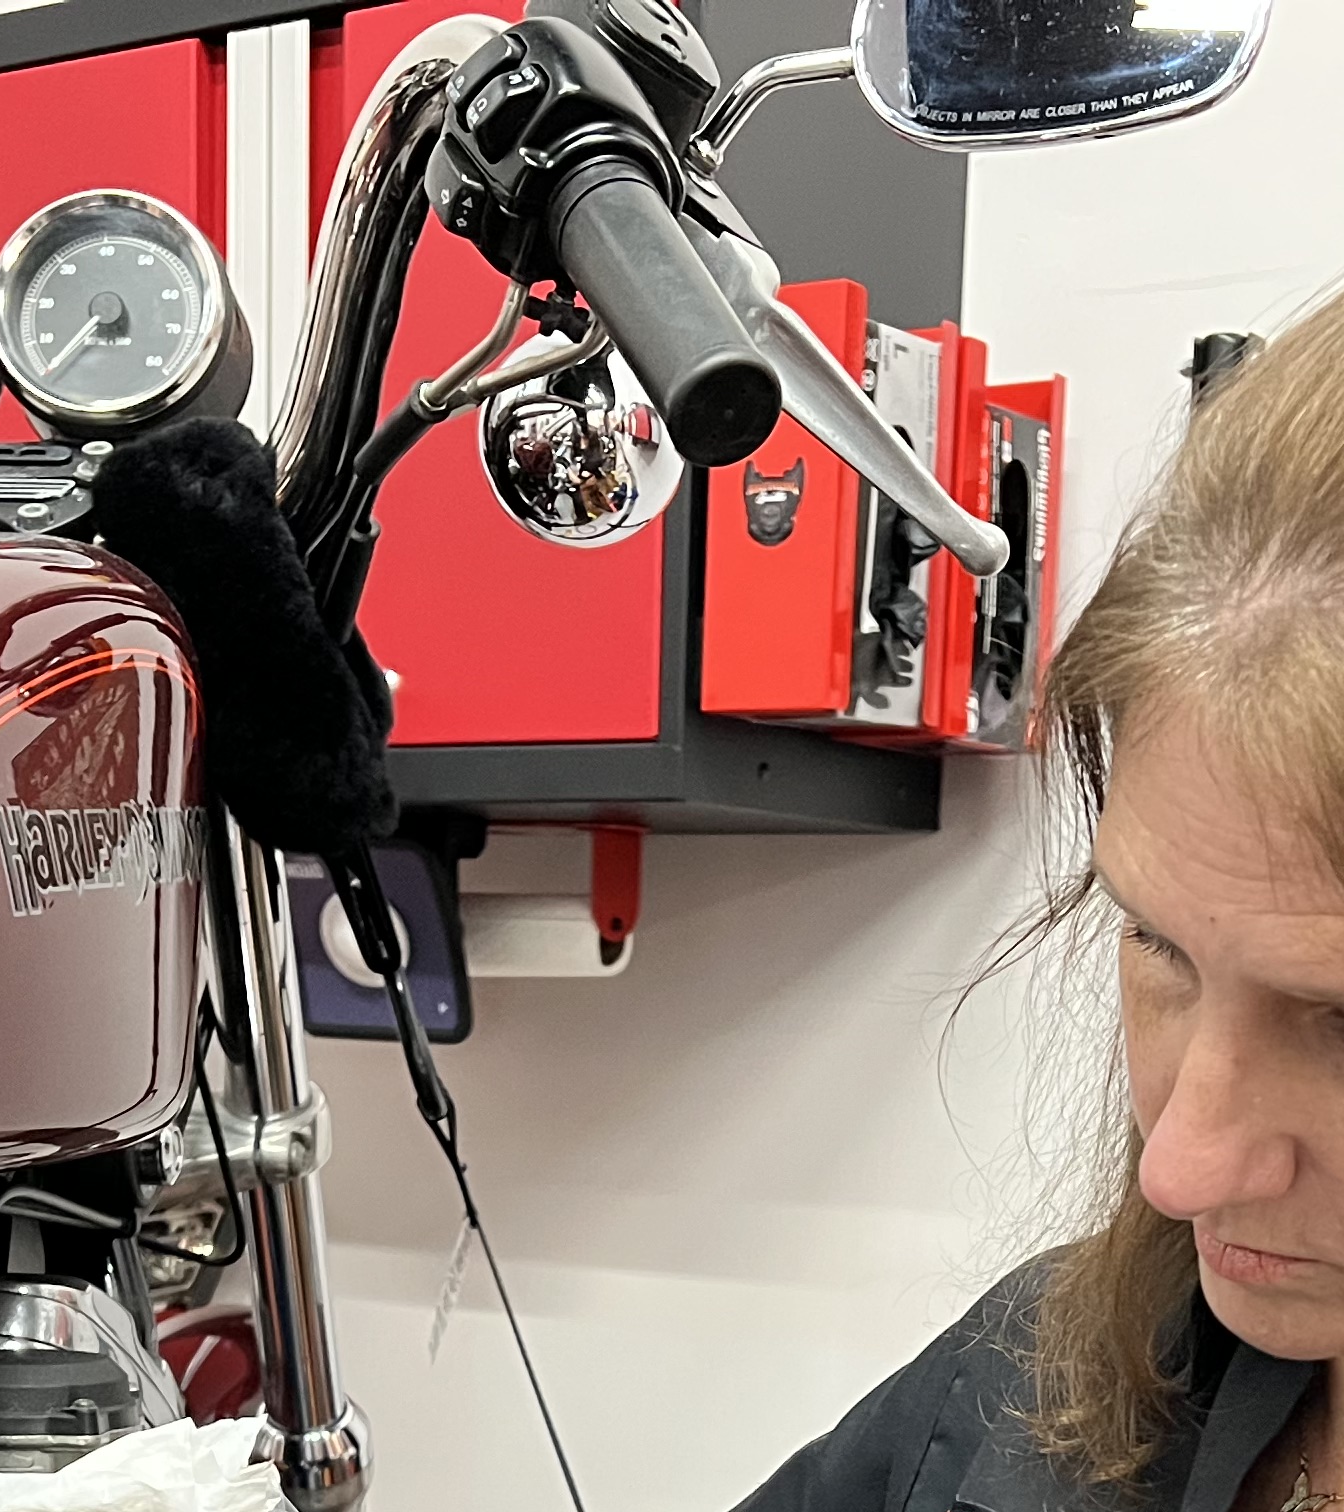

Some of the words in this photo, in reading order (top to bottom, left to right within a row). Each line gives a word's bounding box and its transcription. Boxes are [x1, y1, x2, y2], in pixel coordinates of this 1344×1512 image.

[962, 112, 972, 122] IN
[976, 110, 1016, 121] MIRROR
[1019, 108, 1040, 120] ARE
[1045, 103, 1086, 118] CLOSER
[1090, 98, 1117, 112] THAN
[1121, 91, 1149, 107] THEY
[1152, 79, 1195, 101] APPEAR
[98, 245, 115, 257] 40
[137, 254, 154, 266] 50
[59, 264, 77, 275] 30
[161, 288, 179, 300] 60
[38, 297, 55, 309] 20
[165, 322, 181, 334] 70
[40, 332, 54, 344] 10
[145, 355, 163, 367] 80
